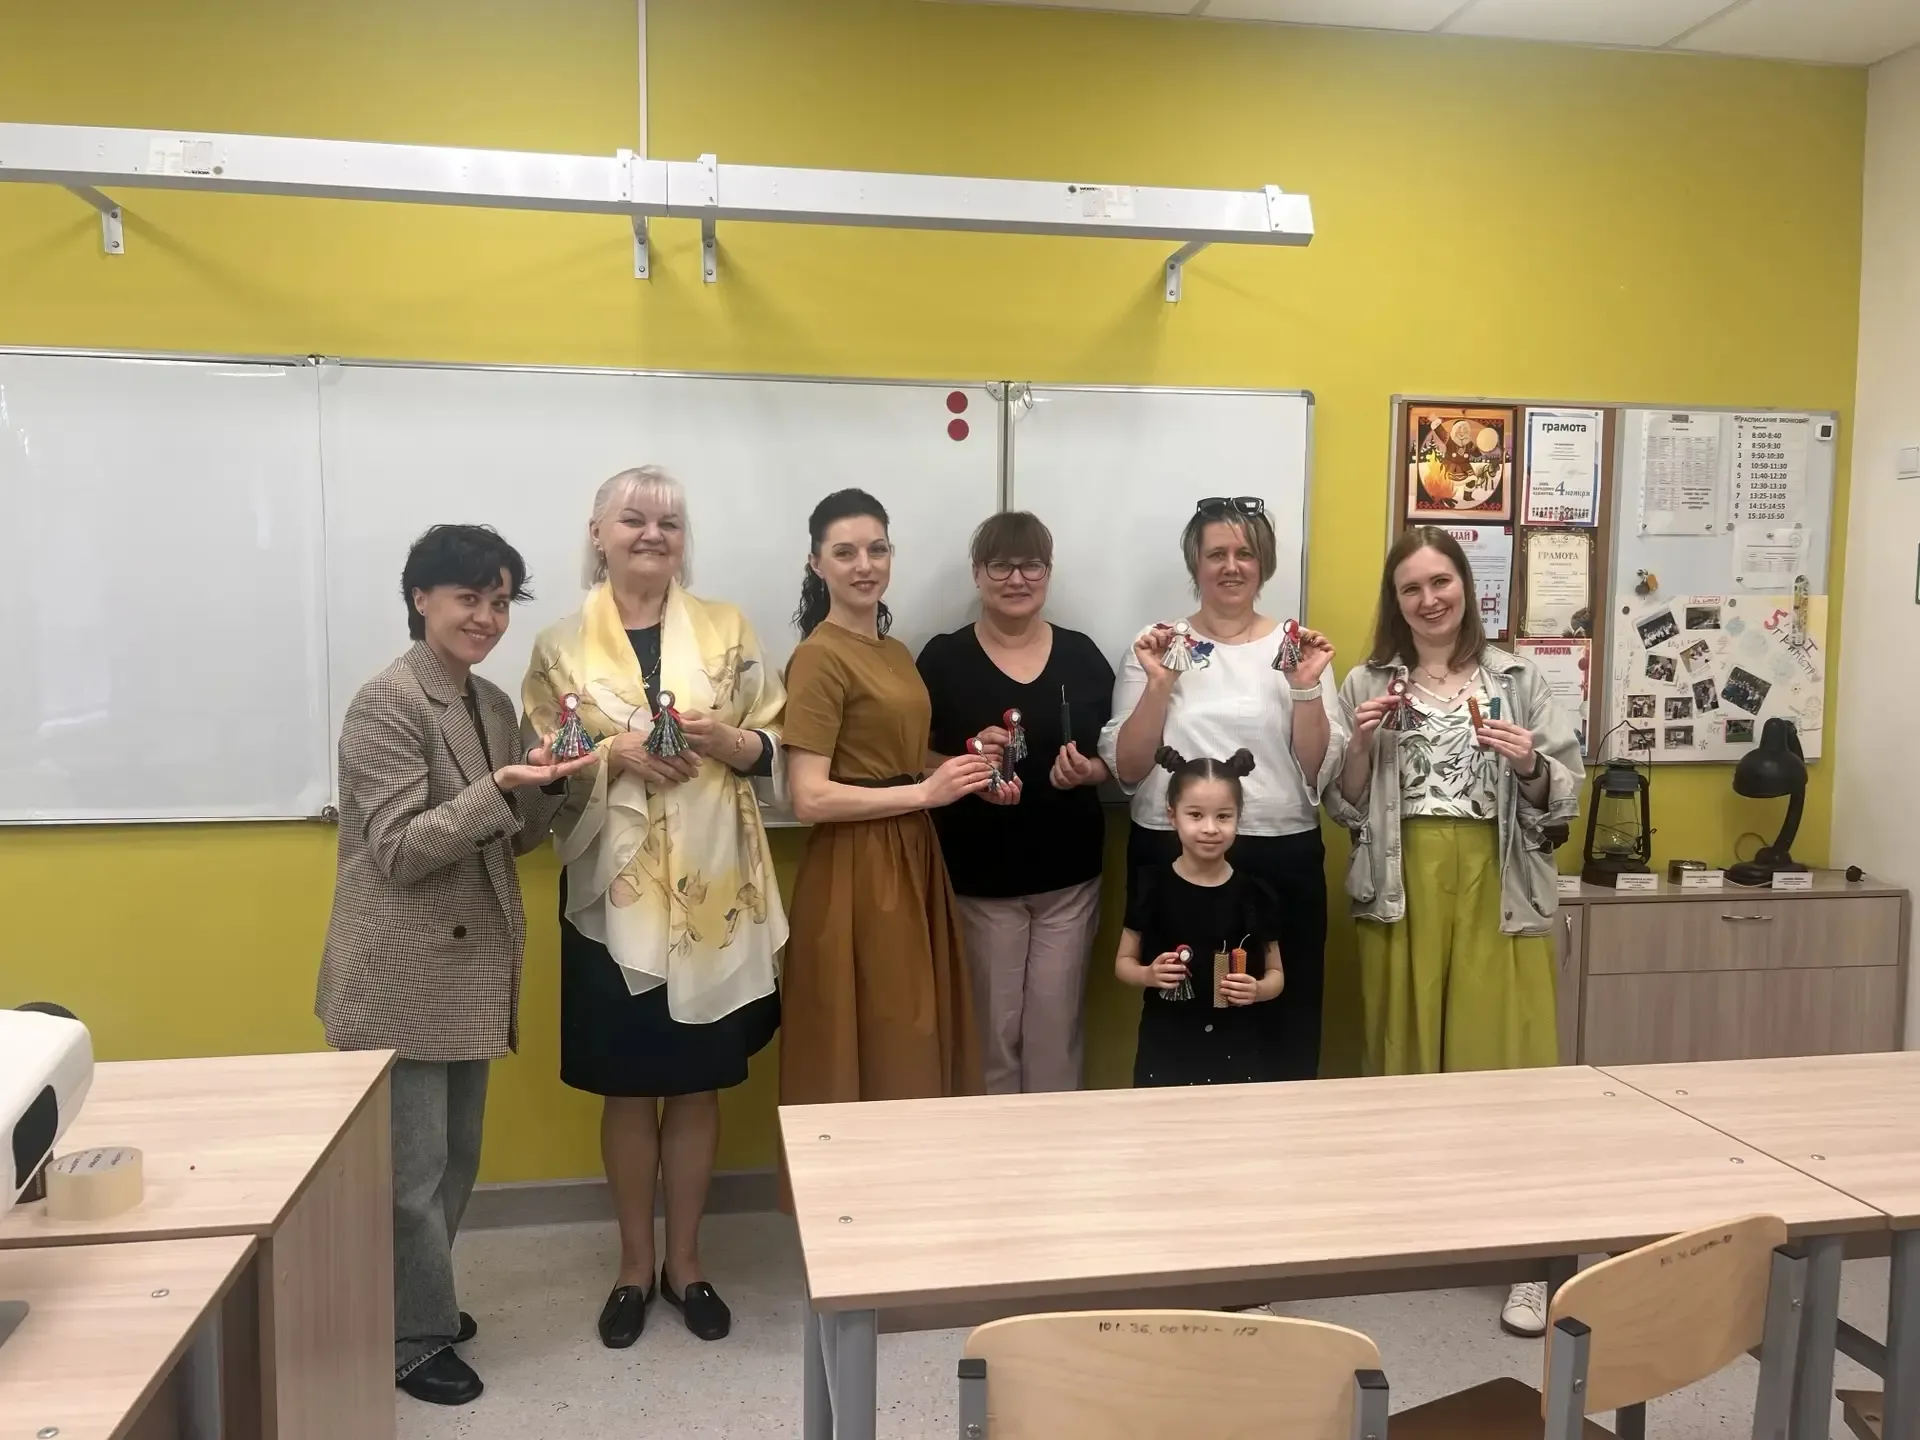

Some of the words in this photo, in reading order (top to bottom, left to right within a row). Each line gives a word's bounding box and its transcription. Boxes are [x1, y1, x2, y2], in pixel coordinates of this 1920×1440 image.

[1542, 423, 1587, 433] грамота
[1555, 480, 1566, 496] 4
[1537, 552, 1579, 560] ГРАМОТА
[1764, 609, 1789, 630] 5
[1534, 647, 1572, 655] ГРАМОТА
